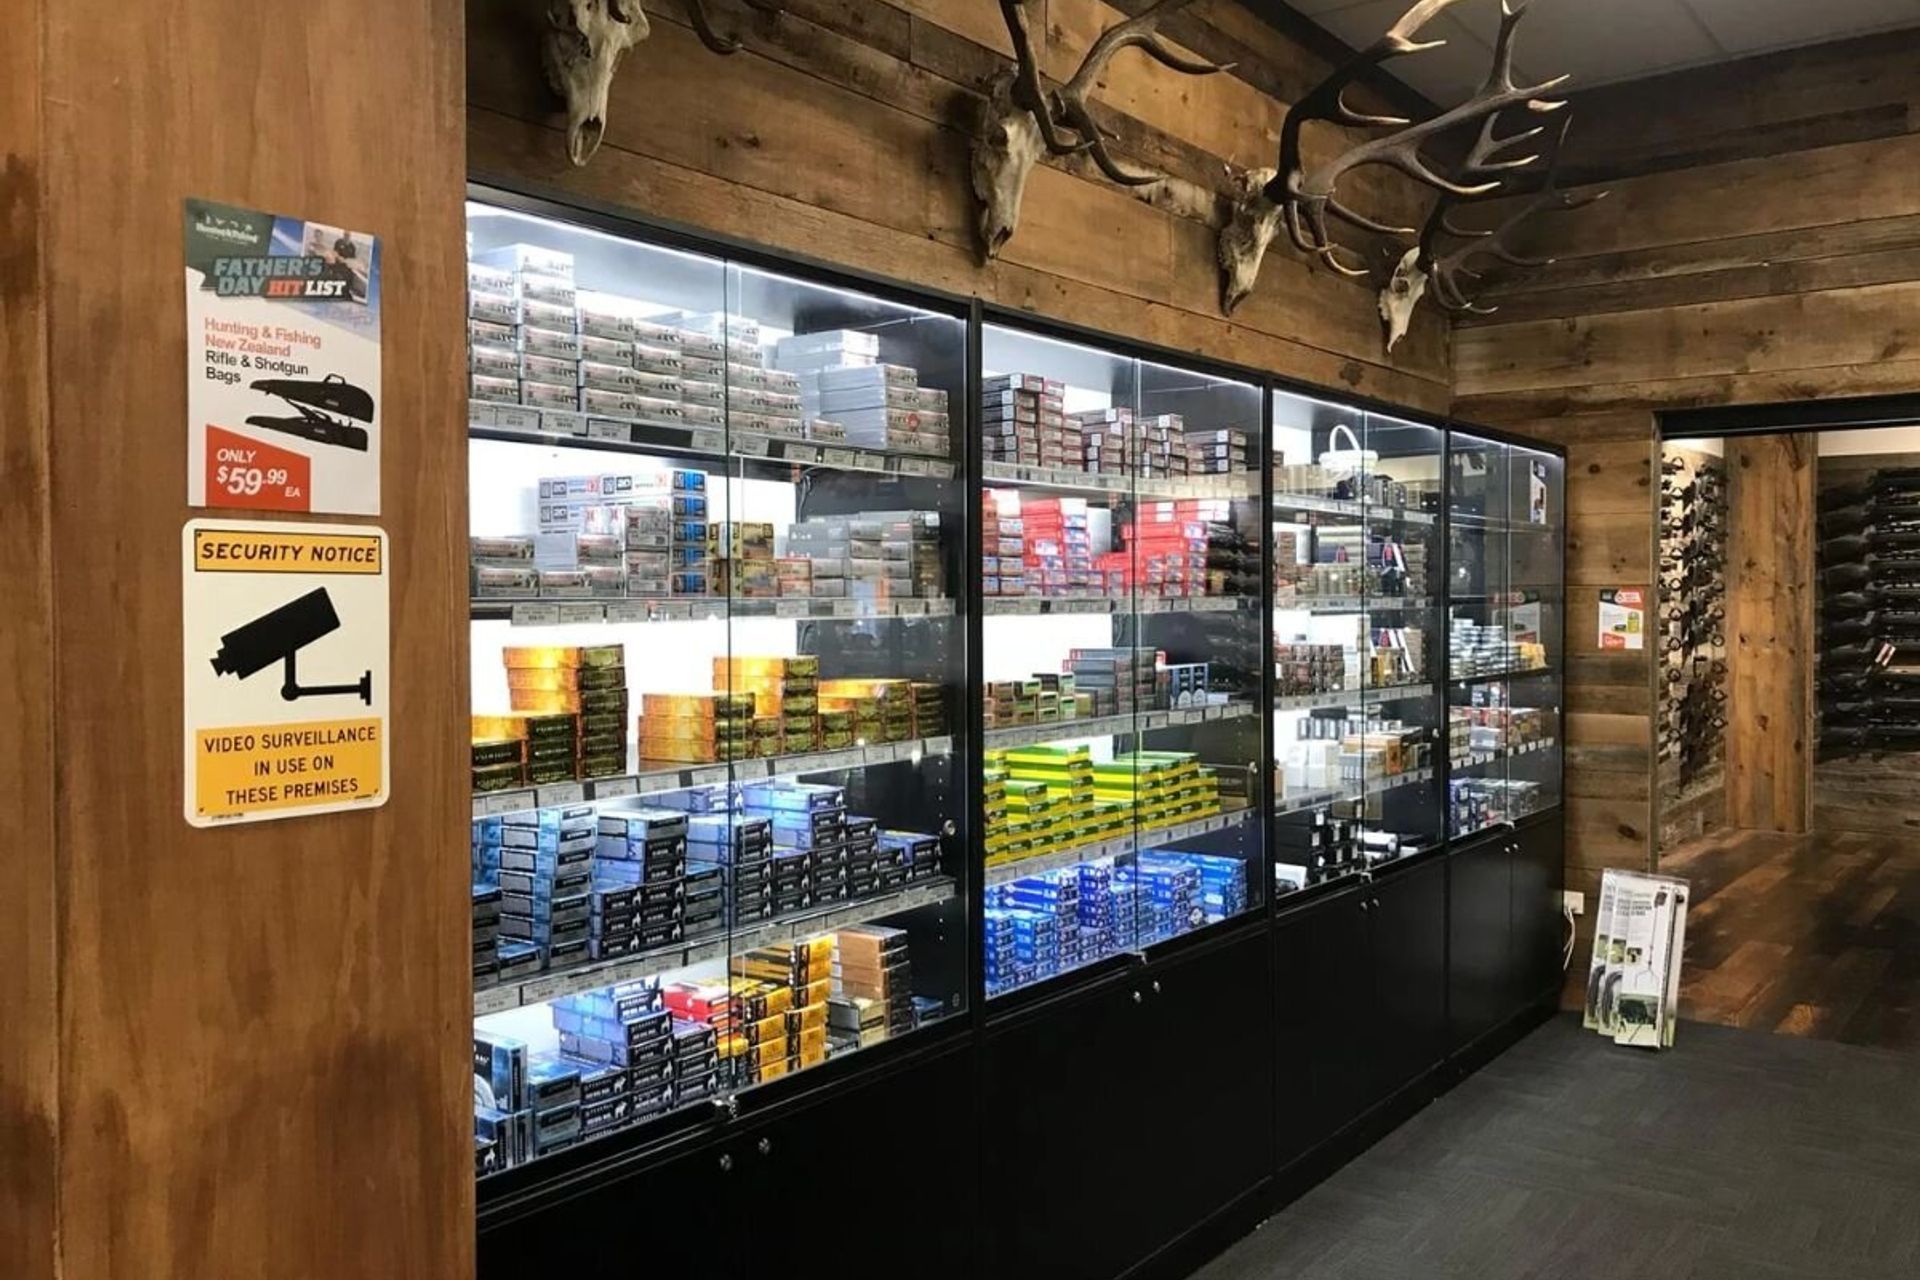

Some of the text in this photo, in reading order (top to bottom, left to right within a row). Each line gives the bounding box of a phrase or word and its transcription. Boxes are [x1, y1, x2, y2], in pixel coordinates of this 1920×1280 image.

[214, 255, 323, 277] FATHER'S
[218, 276, 347, 296] DAY HIT LIST
[204, 317, 321, 349] Hunting & Fishing
[205, 335, 291, 357] New Zealand
[205, 351, 309, 376] Rifle & Shotgun
[206, 367, 241, 384] Bags
[217, 448, 256, 463] ONLY
[285, 486, 301, 498] EA
[201, 543, 376, 563] SECURITY NOTICE
[205, 726, 376, 752] VIDEO SURVEILLANCE
[255, 755, 334, 775] IN USE ON
[226, 778, 358, 805] THESE PREMISES
